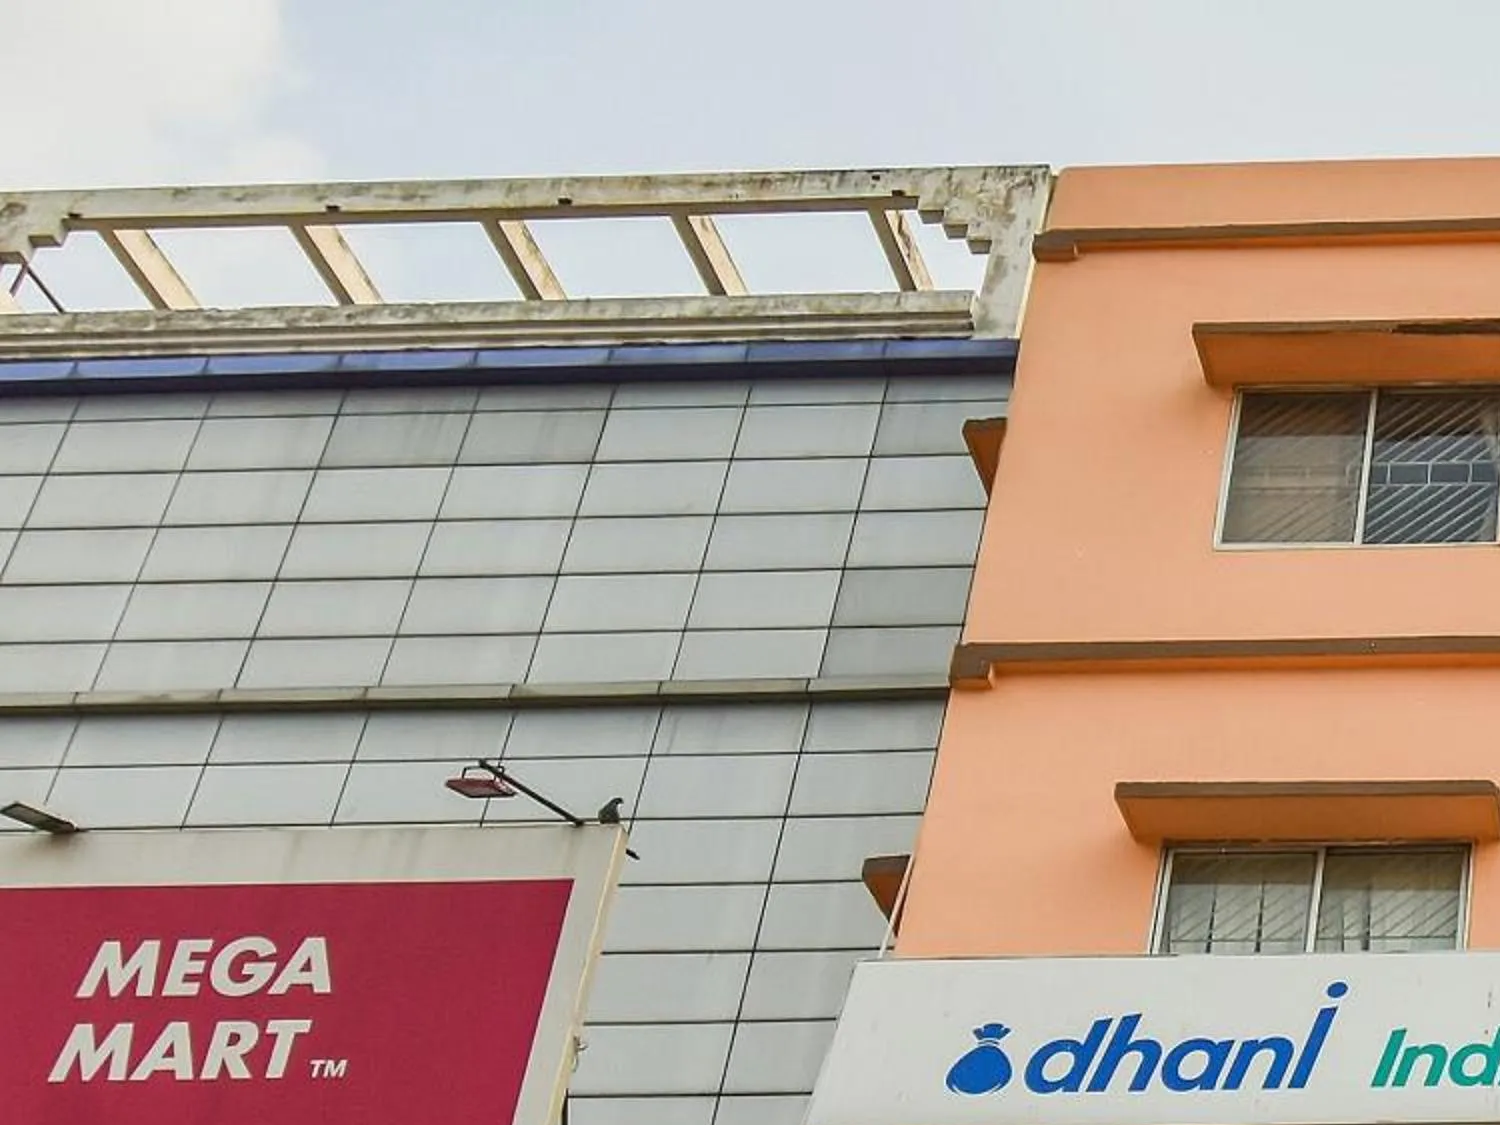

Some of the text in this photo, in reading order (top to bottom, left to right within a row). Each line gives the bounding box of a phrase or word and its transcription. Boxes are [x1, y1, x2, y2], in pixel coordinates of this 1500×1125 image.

[75, 936, 332, 998] MEGA
[47, 1019, 348, 1083] MART TM
[1023, 980, 1349, 1095] dhani
